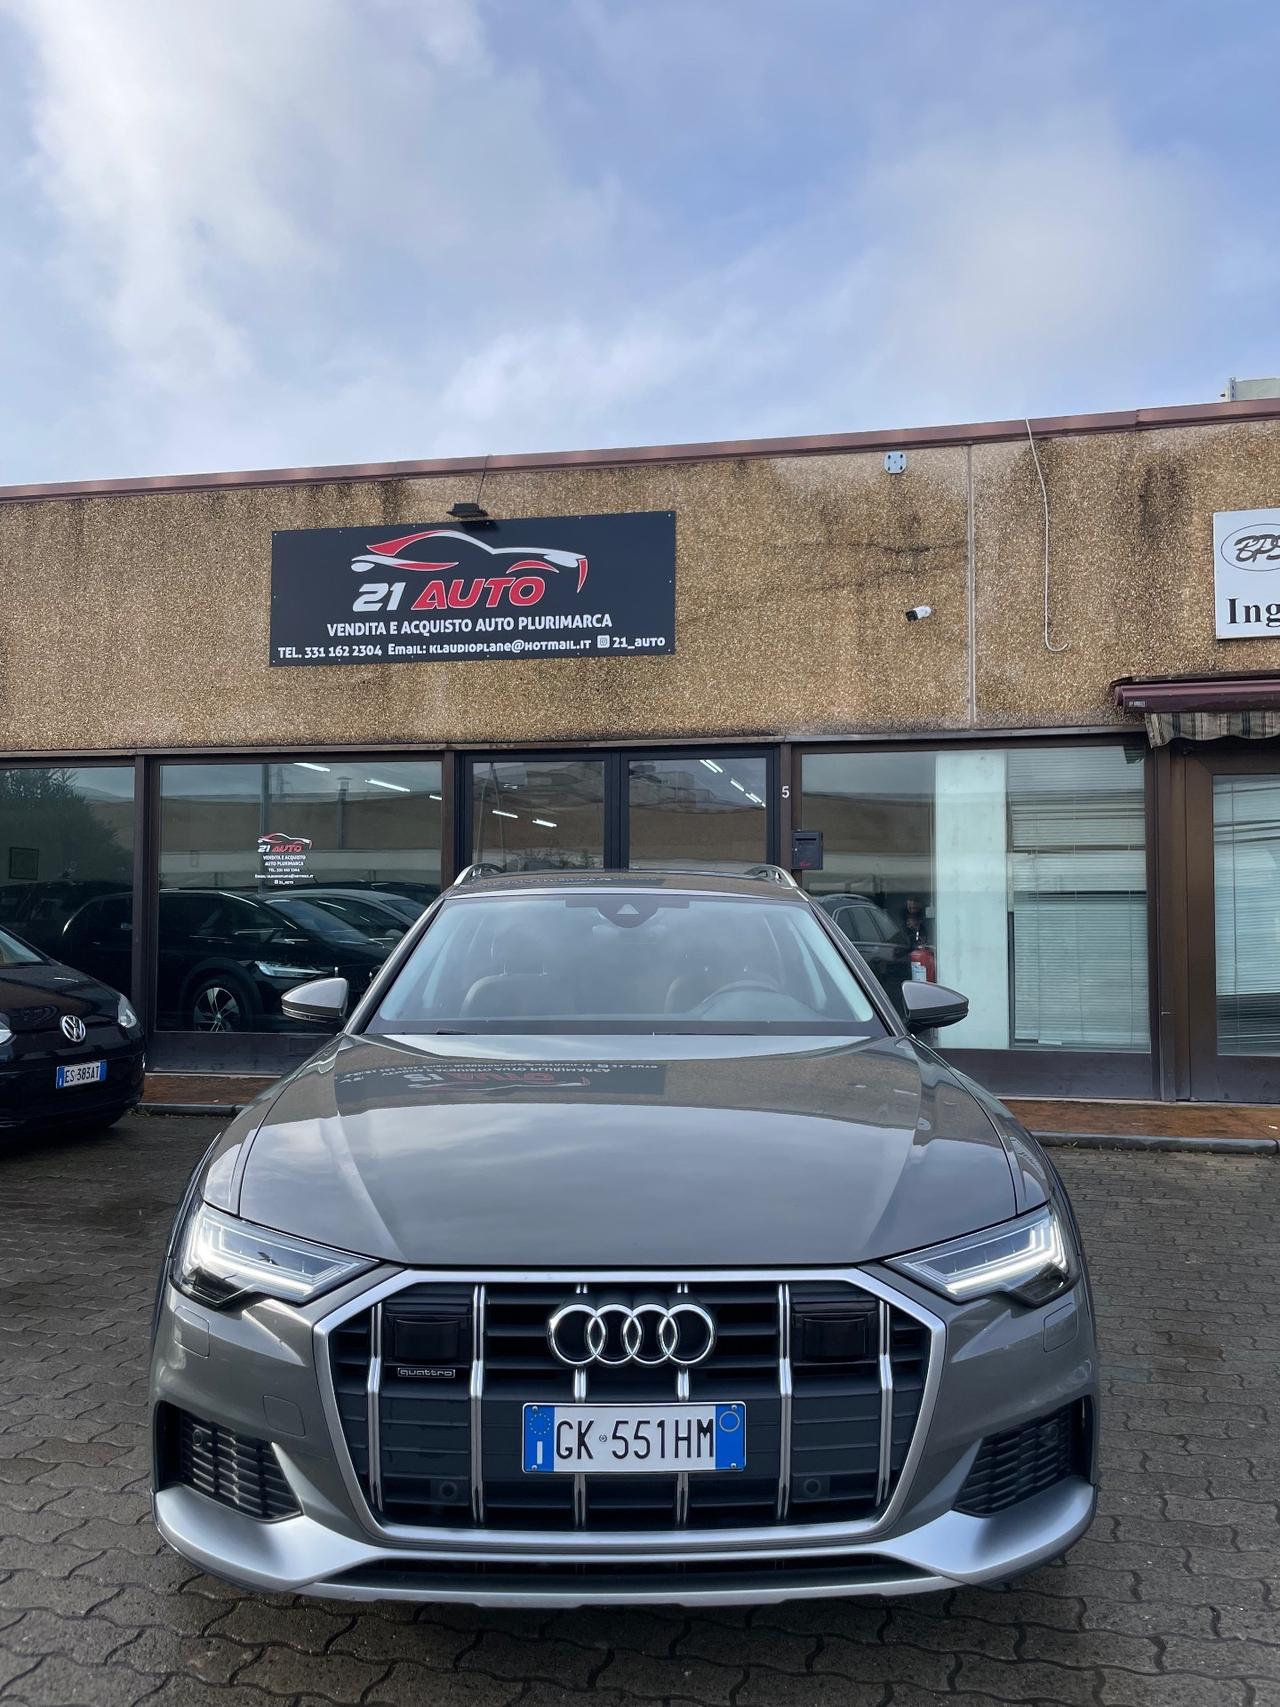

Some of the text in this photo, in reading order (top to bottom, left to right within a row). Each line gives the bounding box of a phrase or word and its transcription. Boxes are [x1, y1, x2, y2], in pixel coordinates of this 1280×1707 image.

[353, 576, 545, 612] 21 AUTO
[327, 614, 613, 637] VENDITA E ACQUISTO AUTO PLURIMARCA
[278, 647, 302, 659] TEL.
[304, 646, 326, 658] 331
[328, 645, 350, 657] 162
[352, 644, 383, 656] 2304
[782, 786, 790, 799] 5
[272, 844, 302, 852] AUTO
[77, 1066, 100, 1081] 383AT
[400, 1369, 453, 1377] quattro
[555, 1418, 715, 1460] GK 551HM
